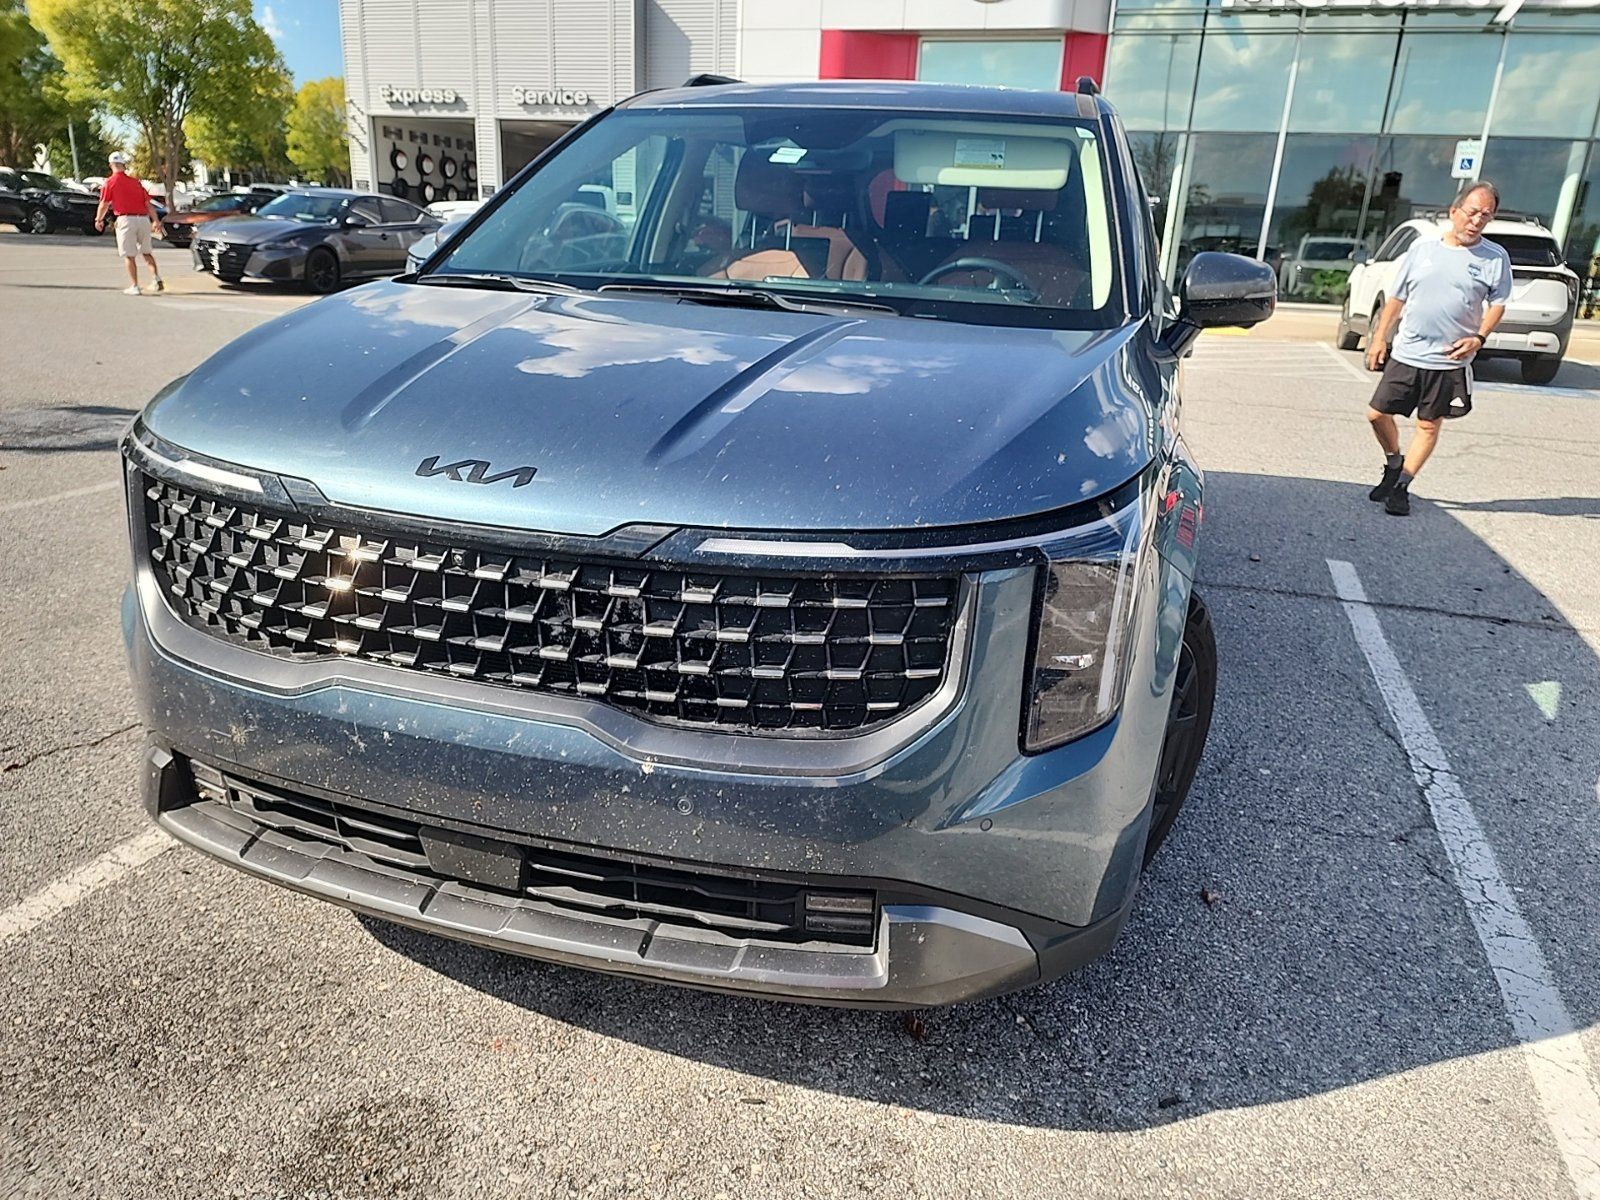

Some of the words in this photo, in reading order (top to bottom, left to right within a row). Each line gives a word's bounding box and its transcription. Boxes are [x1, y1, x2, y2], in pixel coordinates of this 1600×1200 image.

[380, 84, 456, 106] Express
[512, 86, 588, 105] Service
[415, 455, 538, 488] KIA
